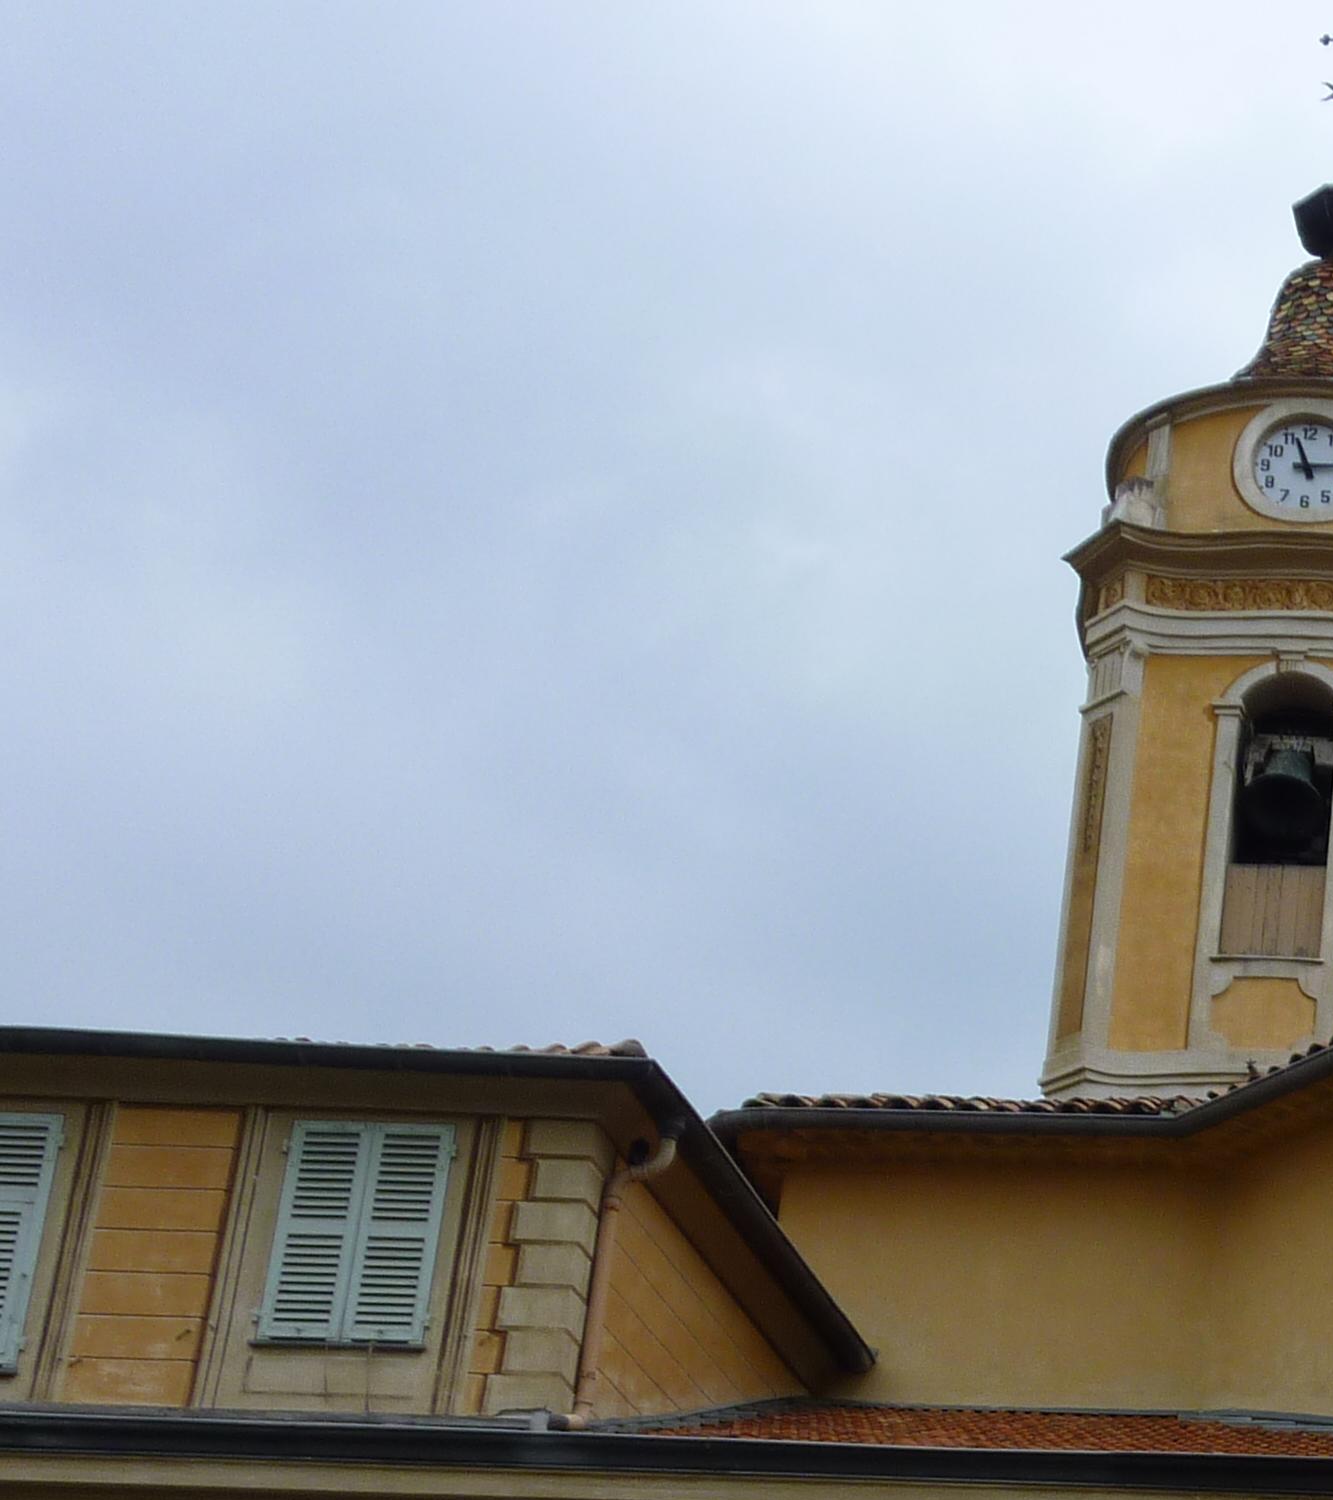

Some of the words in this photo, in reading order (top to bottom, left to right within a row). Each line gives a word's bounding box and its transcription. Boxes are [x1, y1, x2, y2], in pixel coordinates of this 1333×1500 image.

[1282, 432, 1296, 446] 11
[1302, 427, 1318, 441] 12
[1327, 434, 1333, 447] 1
[1268, 445, 1284, 458] 10
[1260, 459, 1271, 472] 9
[1265, 475, 1275, 489] 8
[1280, 488, 1290, 503] 7
[1300, 495, 1310, 509] 6
[1320, 490, 1331, 504] 5
